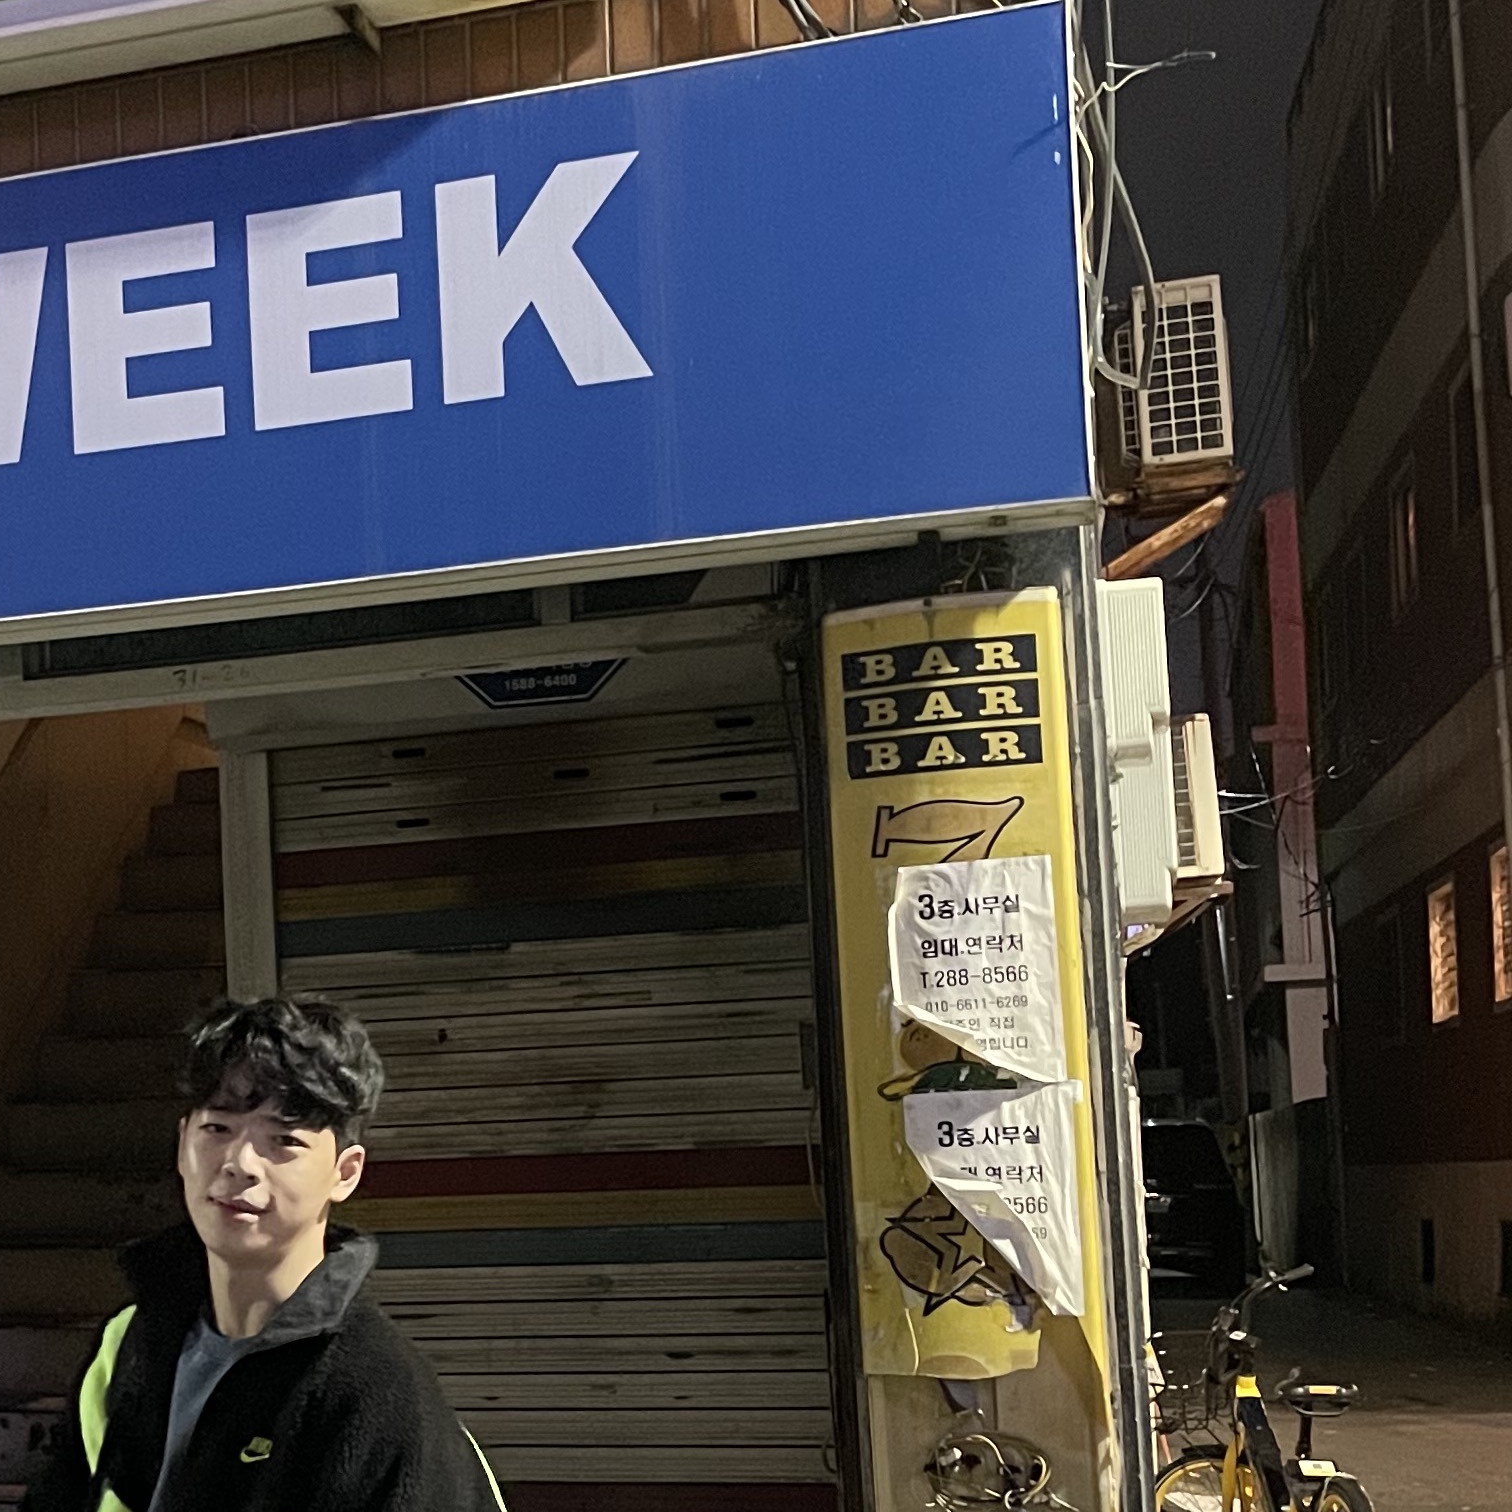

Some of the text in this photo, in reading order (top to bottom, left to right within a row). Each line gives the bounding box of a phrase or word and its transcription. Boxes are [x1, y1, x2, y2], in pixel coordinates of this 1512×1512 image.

[859, 640, 1021, 684] BAR
[861, 684, 1023, 728] BAR
[864, 729, 1026, 773] BAR
